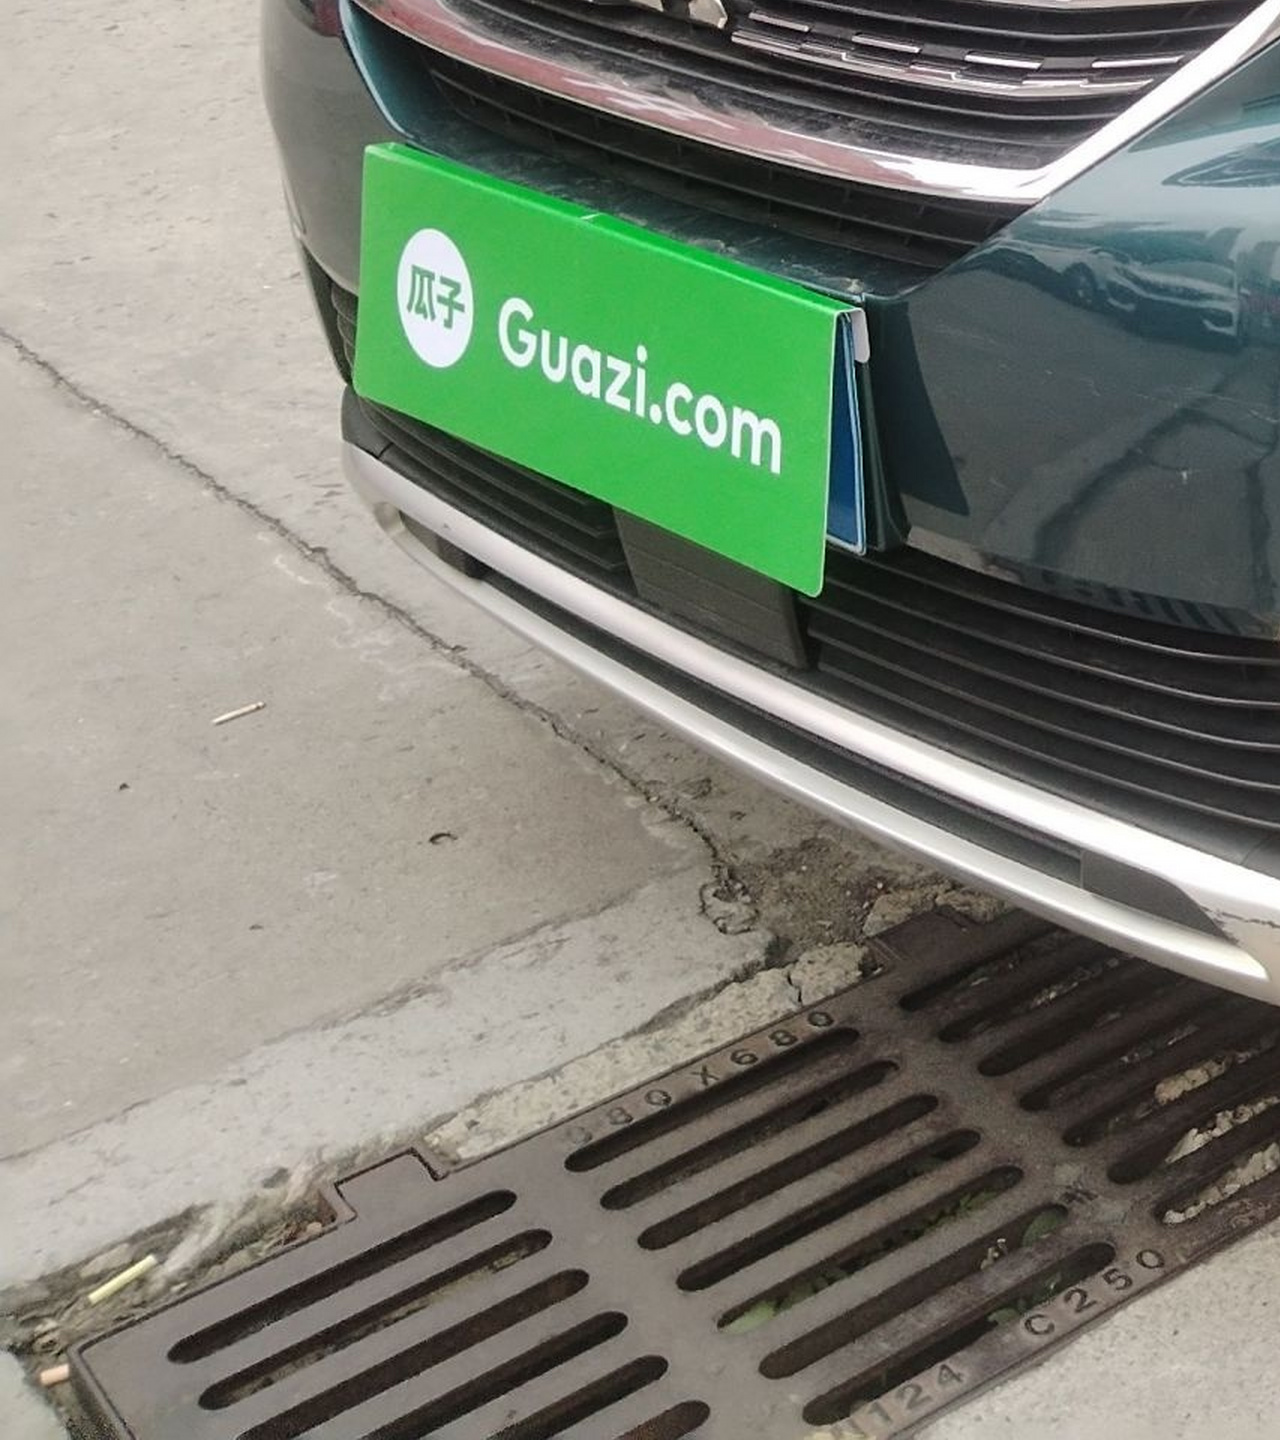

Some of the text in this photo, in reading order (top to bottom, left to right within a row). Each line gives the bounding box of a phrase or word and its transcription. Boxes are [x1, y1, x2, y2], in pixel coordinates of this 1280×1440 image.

[406, 263, 466, 330] 瓜子
[498, 297, 783, 475] Guazi.com
[1024, 1249, 1165, 1336] C250
